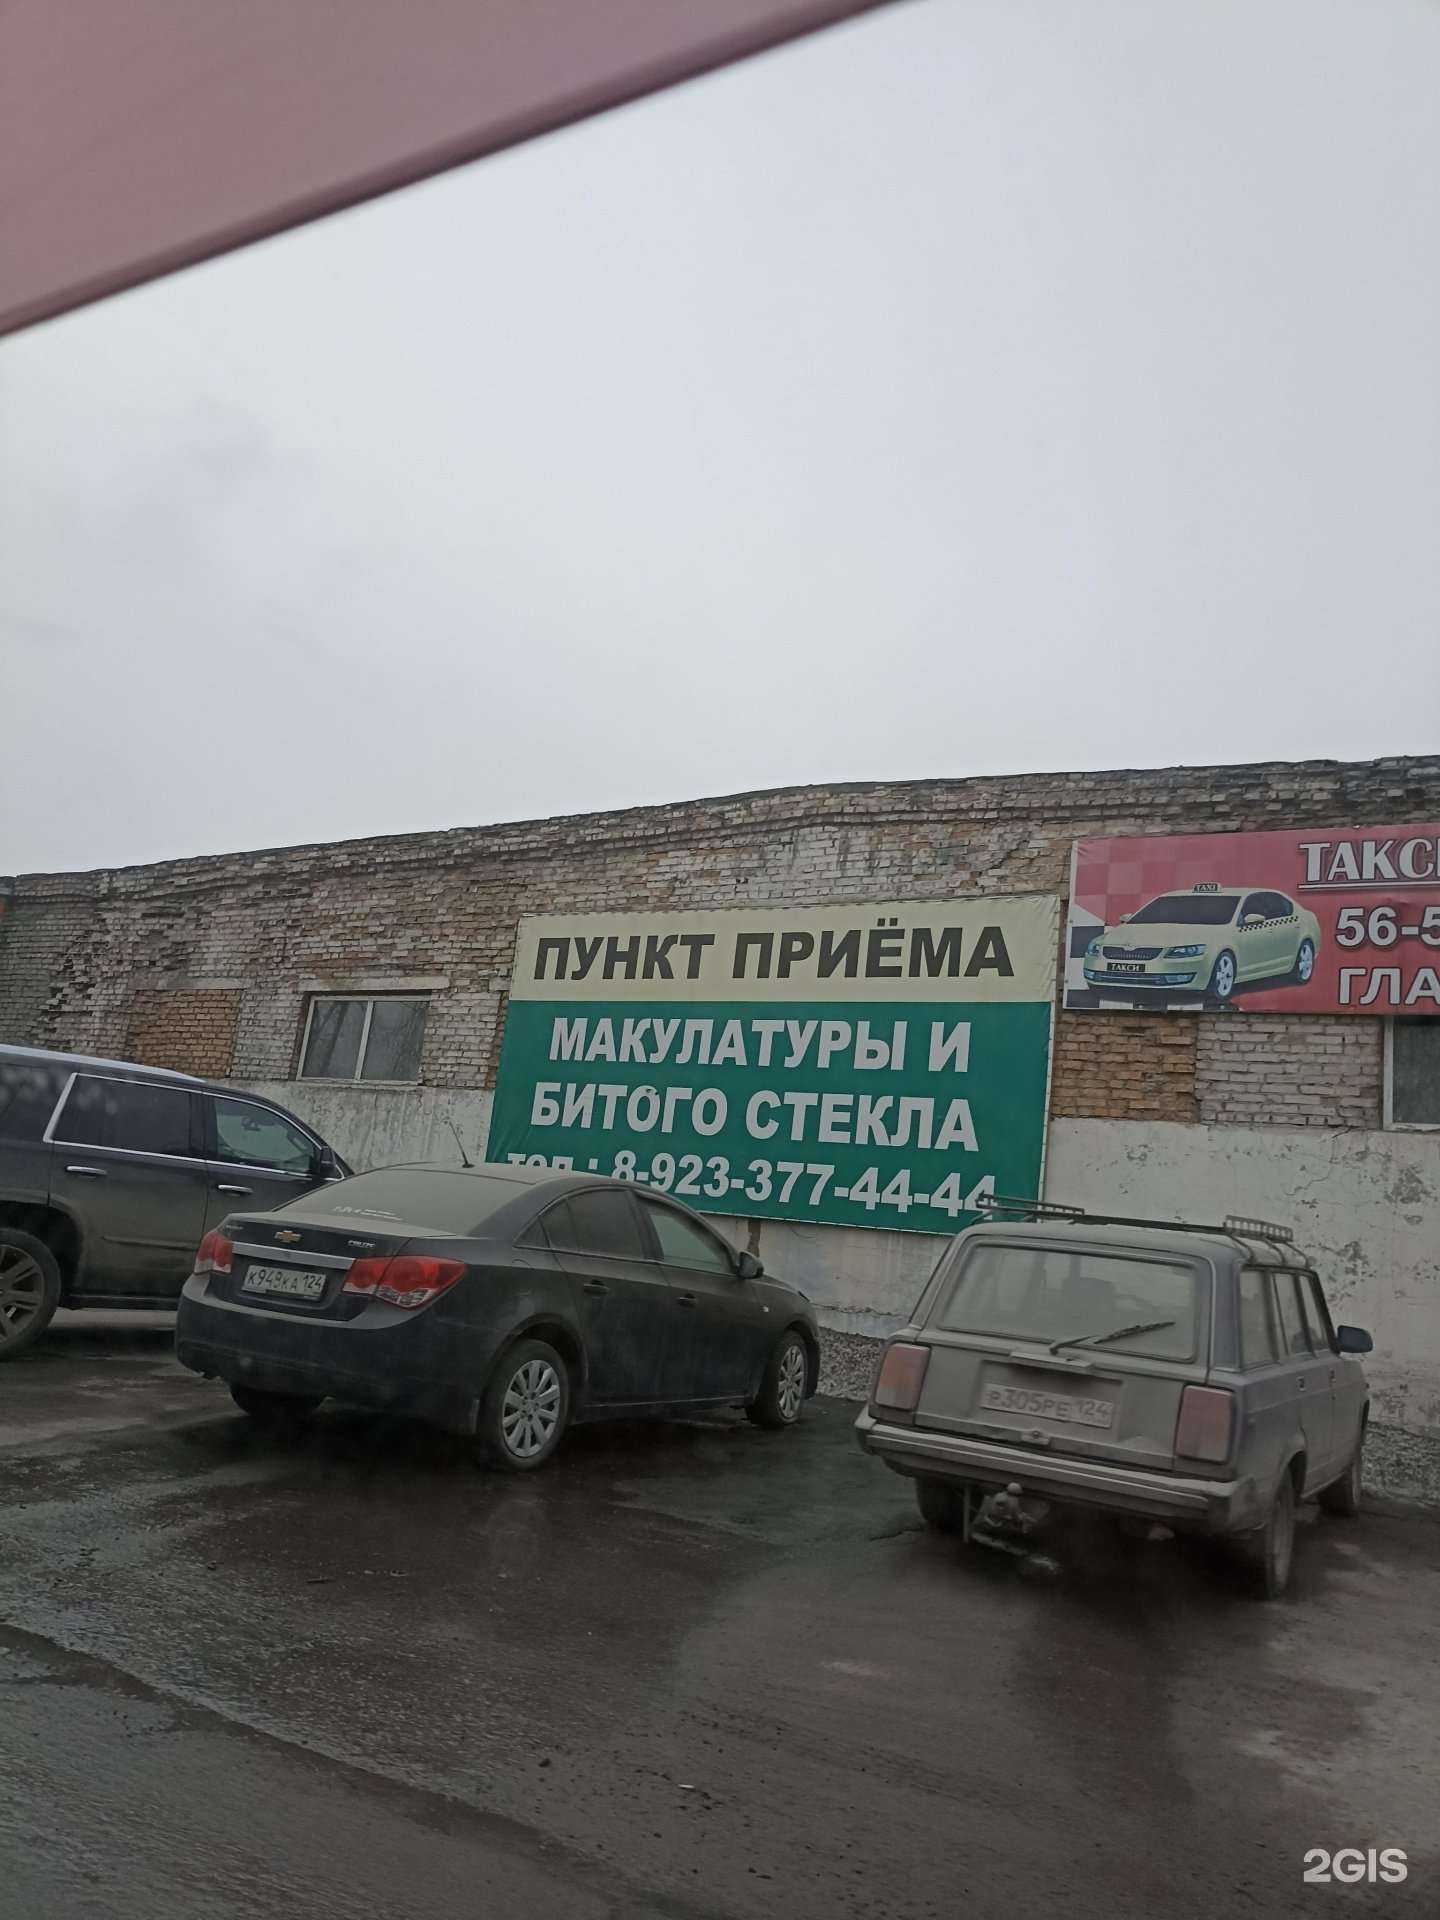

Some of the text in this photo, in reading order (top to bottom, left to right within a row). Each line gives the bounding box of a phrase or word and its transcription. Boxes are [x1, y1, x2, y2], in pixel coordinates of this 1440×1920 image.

[1299, 838, 1440, 882] ТАКС
[533, 918, 1015, 981] ПУНКТ ПРИЁМА
[548, 1016, 972, 1074] МАКУЛАТУРЫ И
[530, 1081, 980, 1153] БИТОГО СТЕКЛА
[611, 1149, 998, 1221] 8-923-377-44-44
